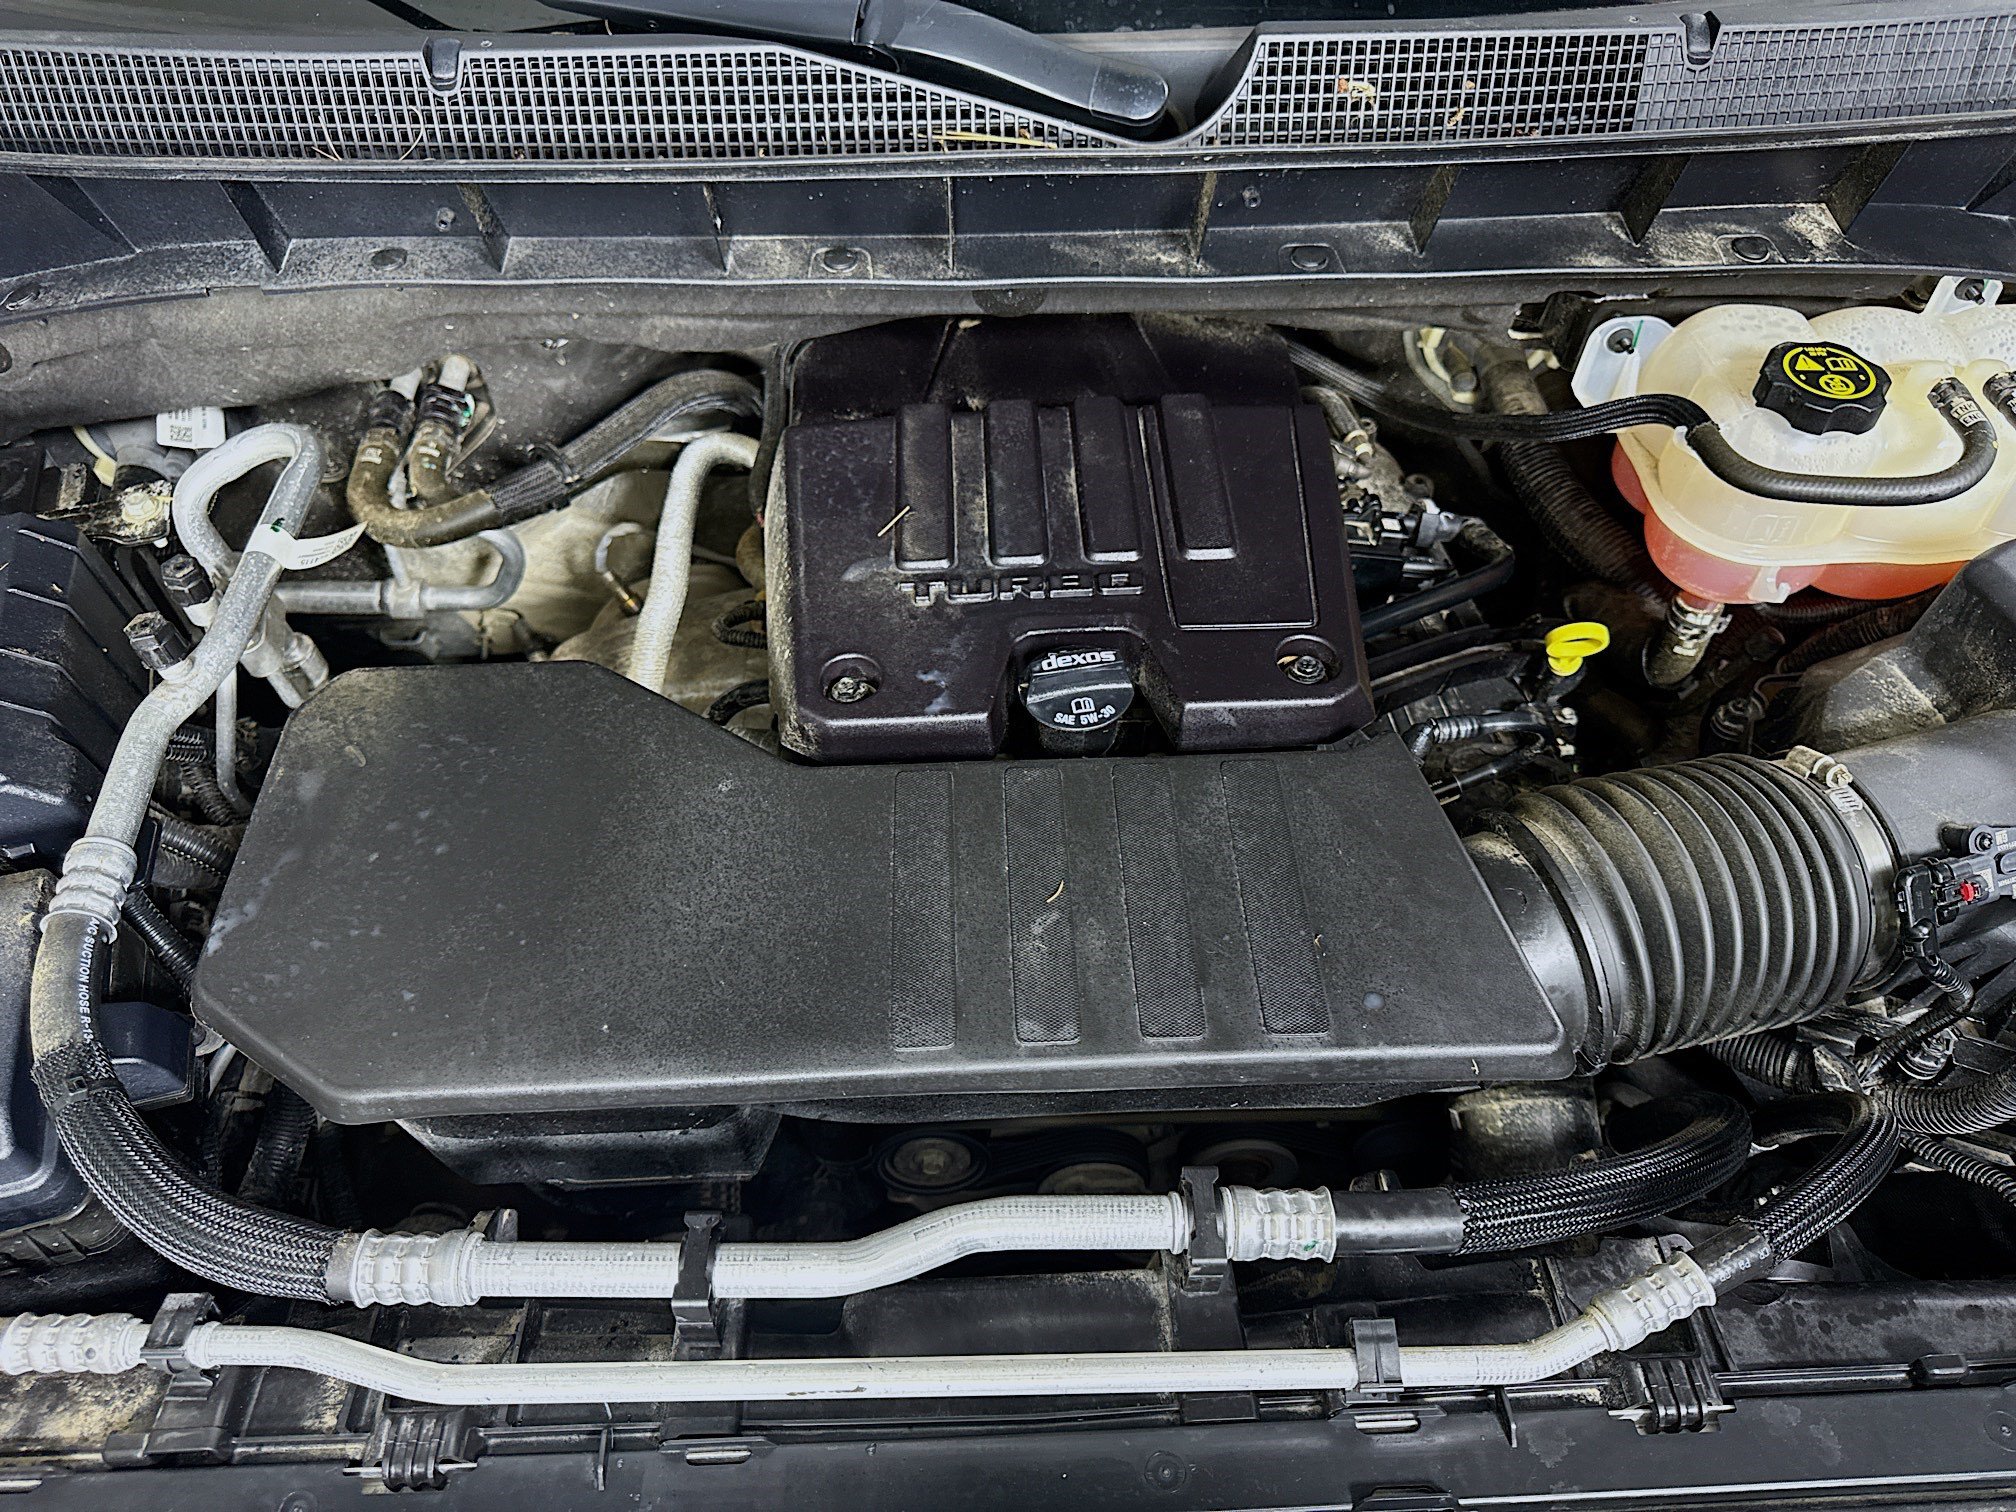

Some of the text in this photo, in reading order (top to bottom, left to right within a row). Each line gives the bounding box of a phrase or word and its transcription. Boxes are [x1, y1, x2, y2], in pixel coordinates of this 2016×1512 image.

[898, 572, 1145, 607] TURBO
[1041, 650, 1118, 672] dexos
[1054, 704, 1116, 726] SAE 5W-30
[87, 916, 100, 935] A/C
[78, 937, 96, 983] SUCTION
[78, 985, 90, 1014] HOSE
